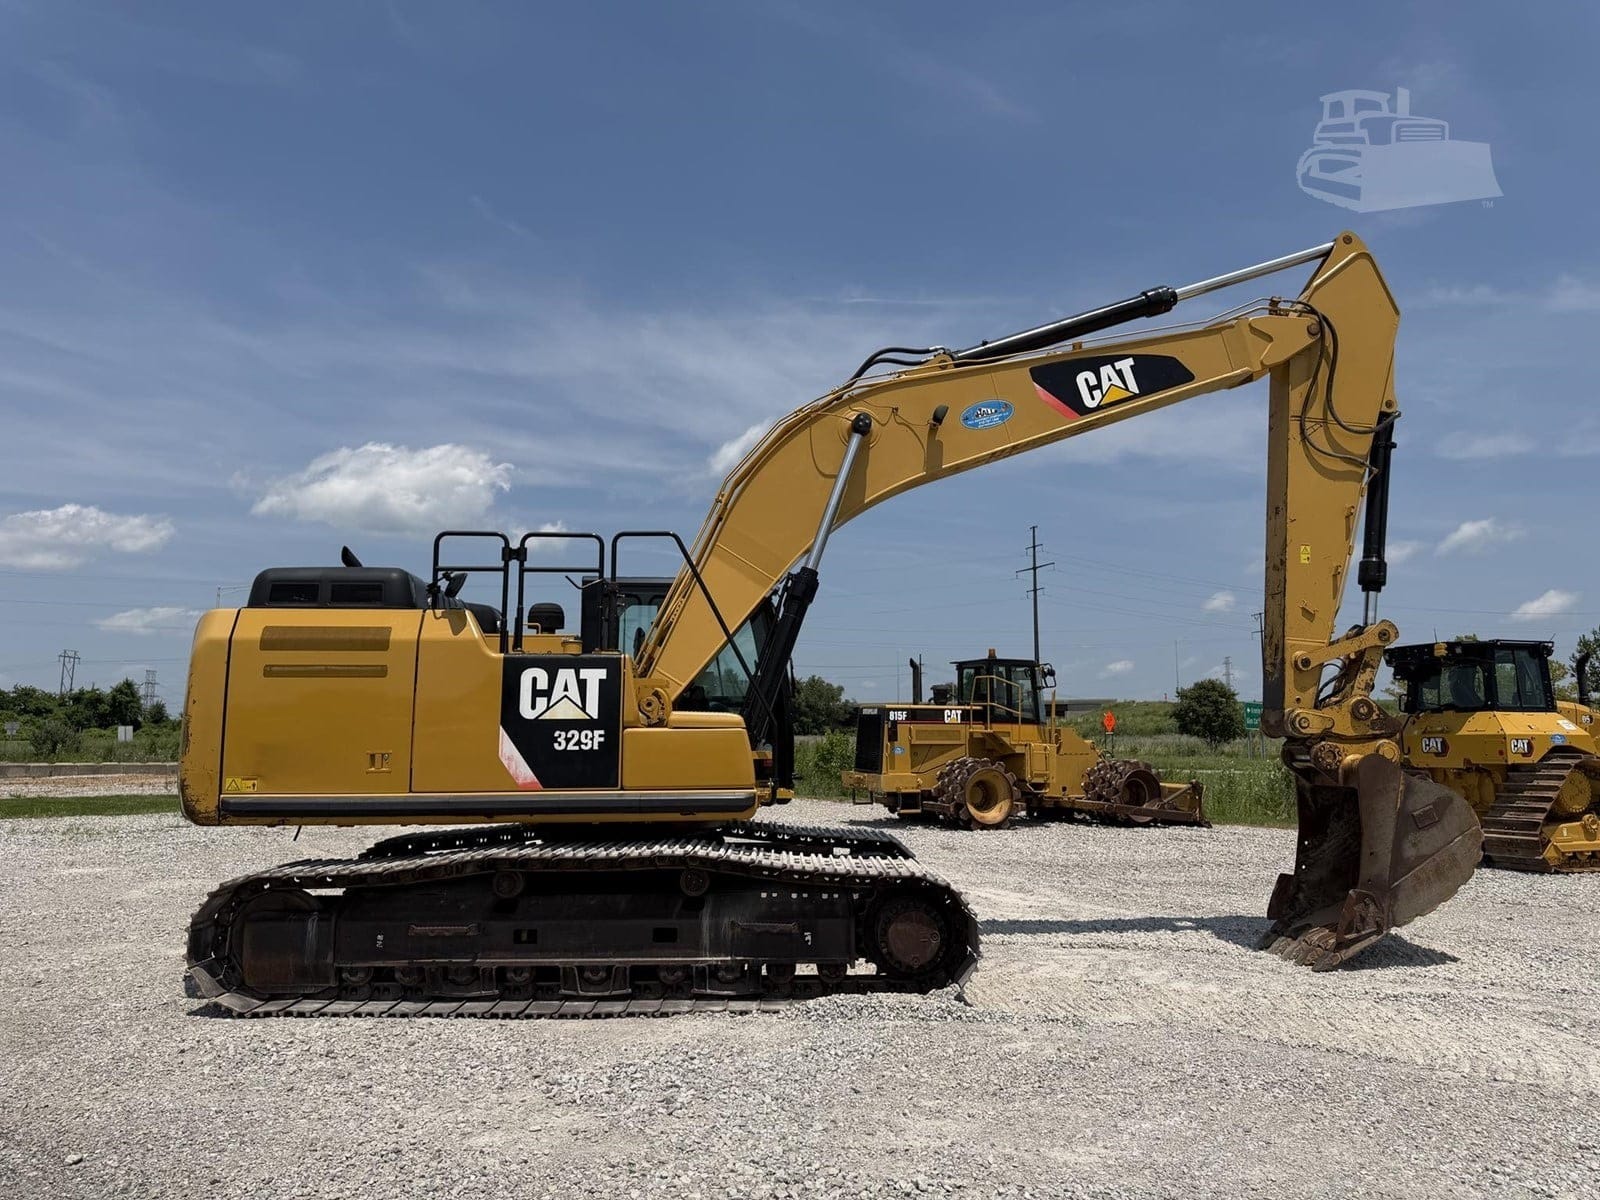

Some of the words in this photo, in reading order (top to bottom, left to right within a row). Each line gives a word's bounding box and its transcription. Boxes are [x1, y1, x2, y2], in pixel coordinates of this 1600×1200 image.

[1076, 357, 1140, 409] CAT
[519, 667, 607, 720] CAT
[889, 710, 908, 721] 815F
[944, 709, 962, 723] CAT
[553, 729, 605, 751] 329F
[1421, 737, 1443, 753] CAT
[1511, 739, 1529, 753] CAT
